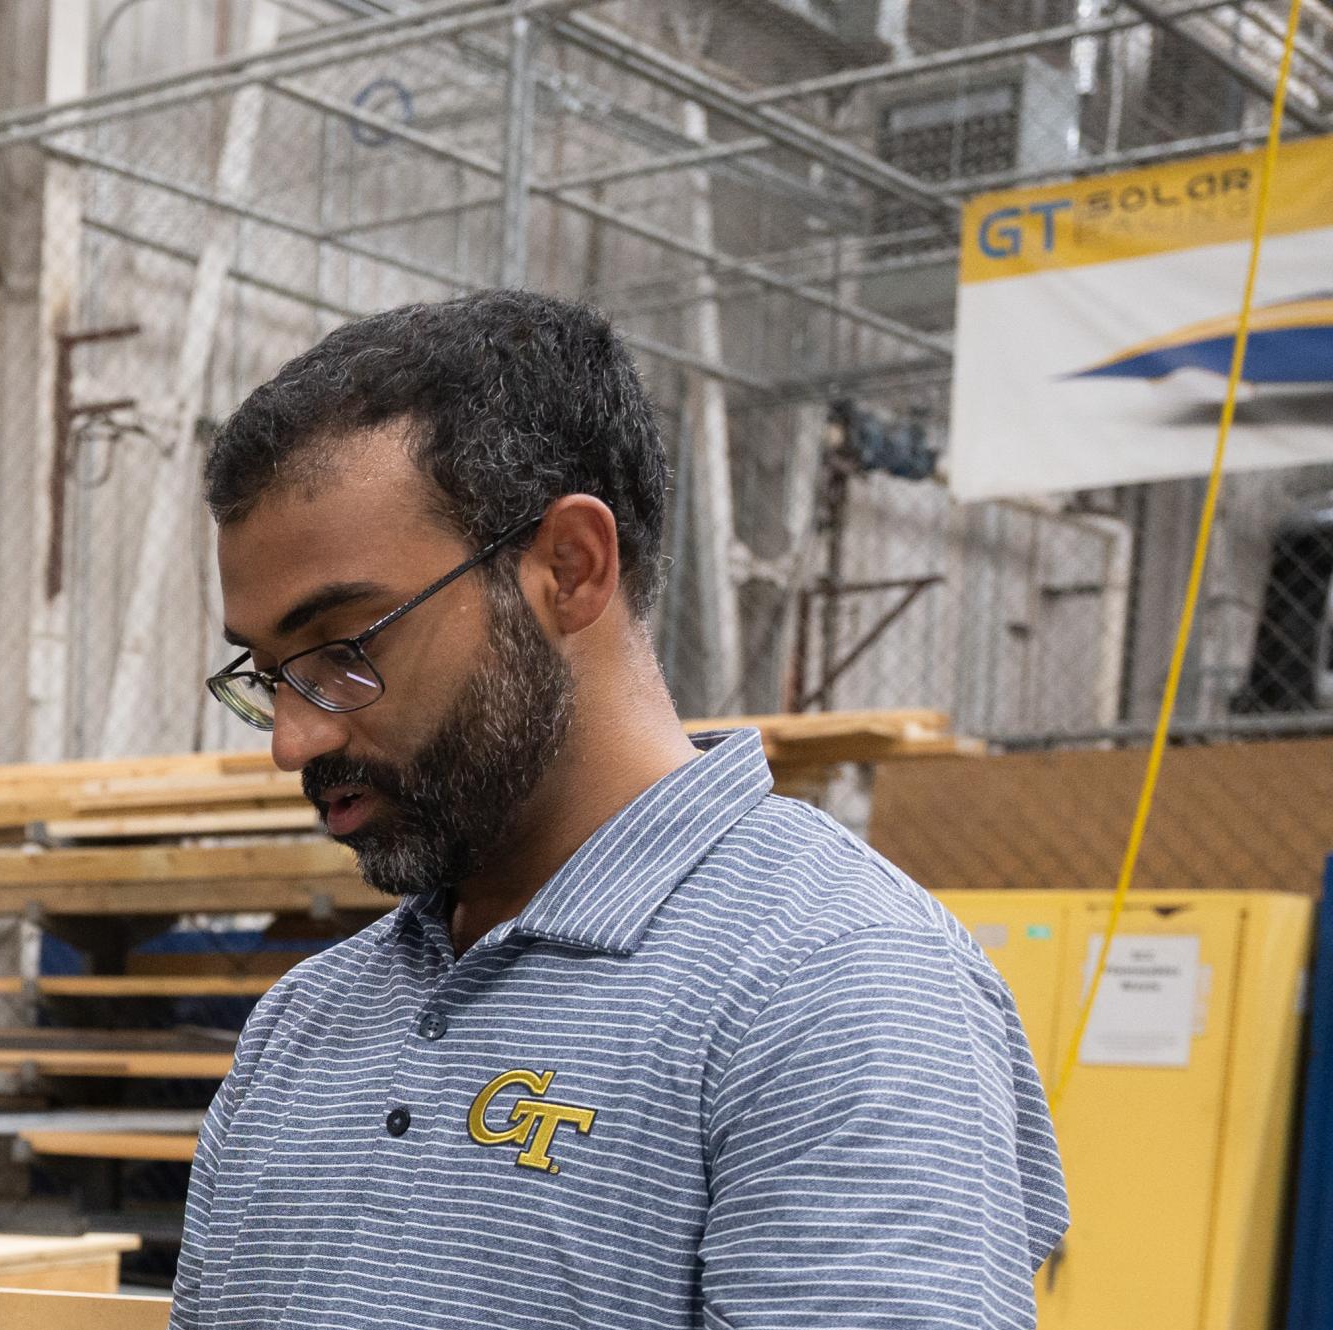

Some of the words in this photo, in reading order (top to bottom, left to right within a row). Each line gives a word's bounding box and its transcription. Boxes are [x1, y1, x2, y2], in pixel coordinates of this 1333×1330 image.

[978, 200, 1072, 259] GT
[1086, 168, 1251, 215] SOLAR
[468, 1068, 598, 1171] GT
